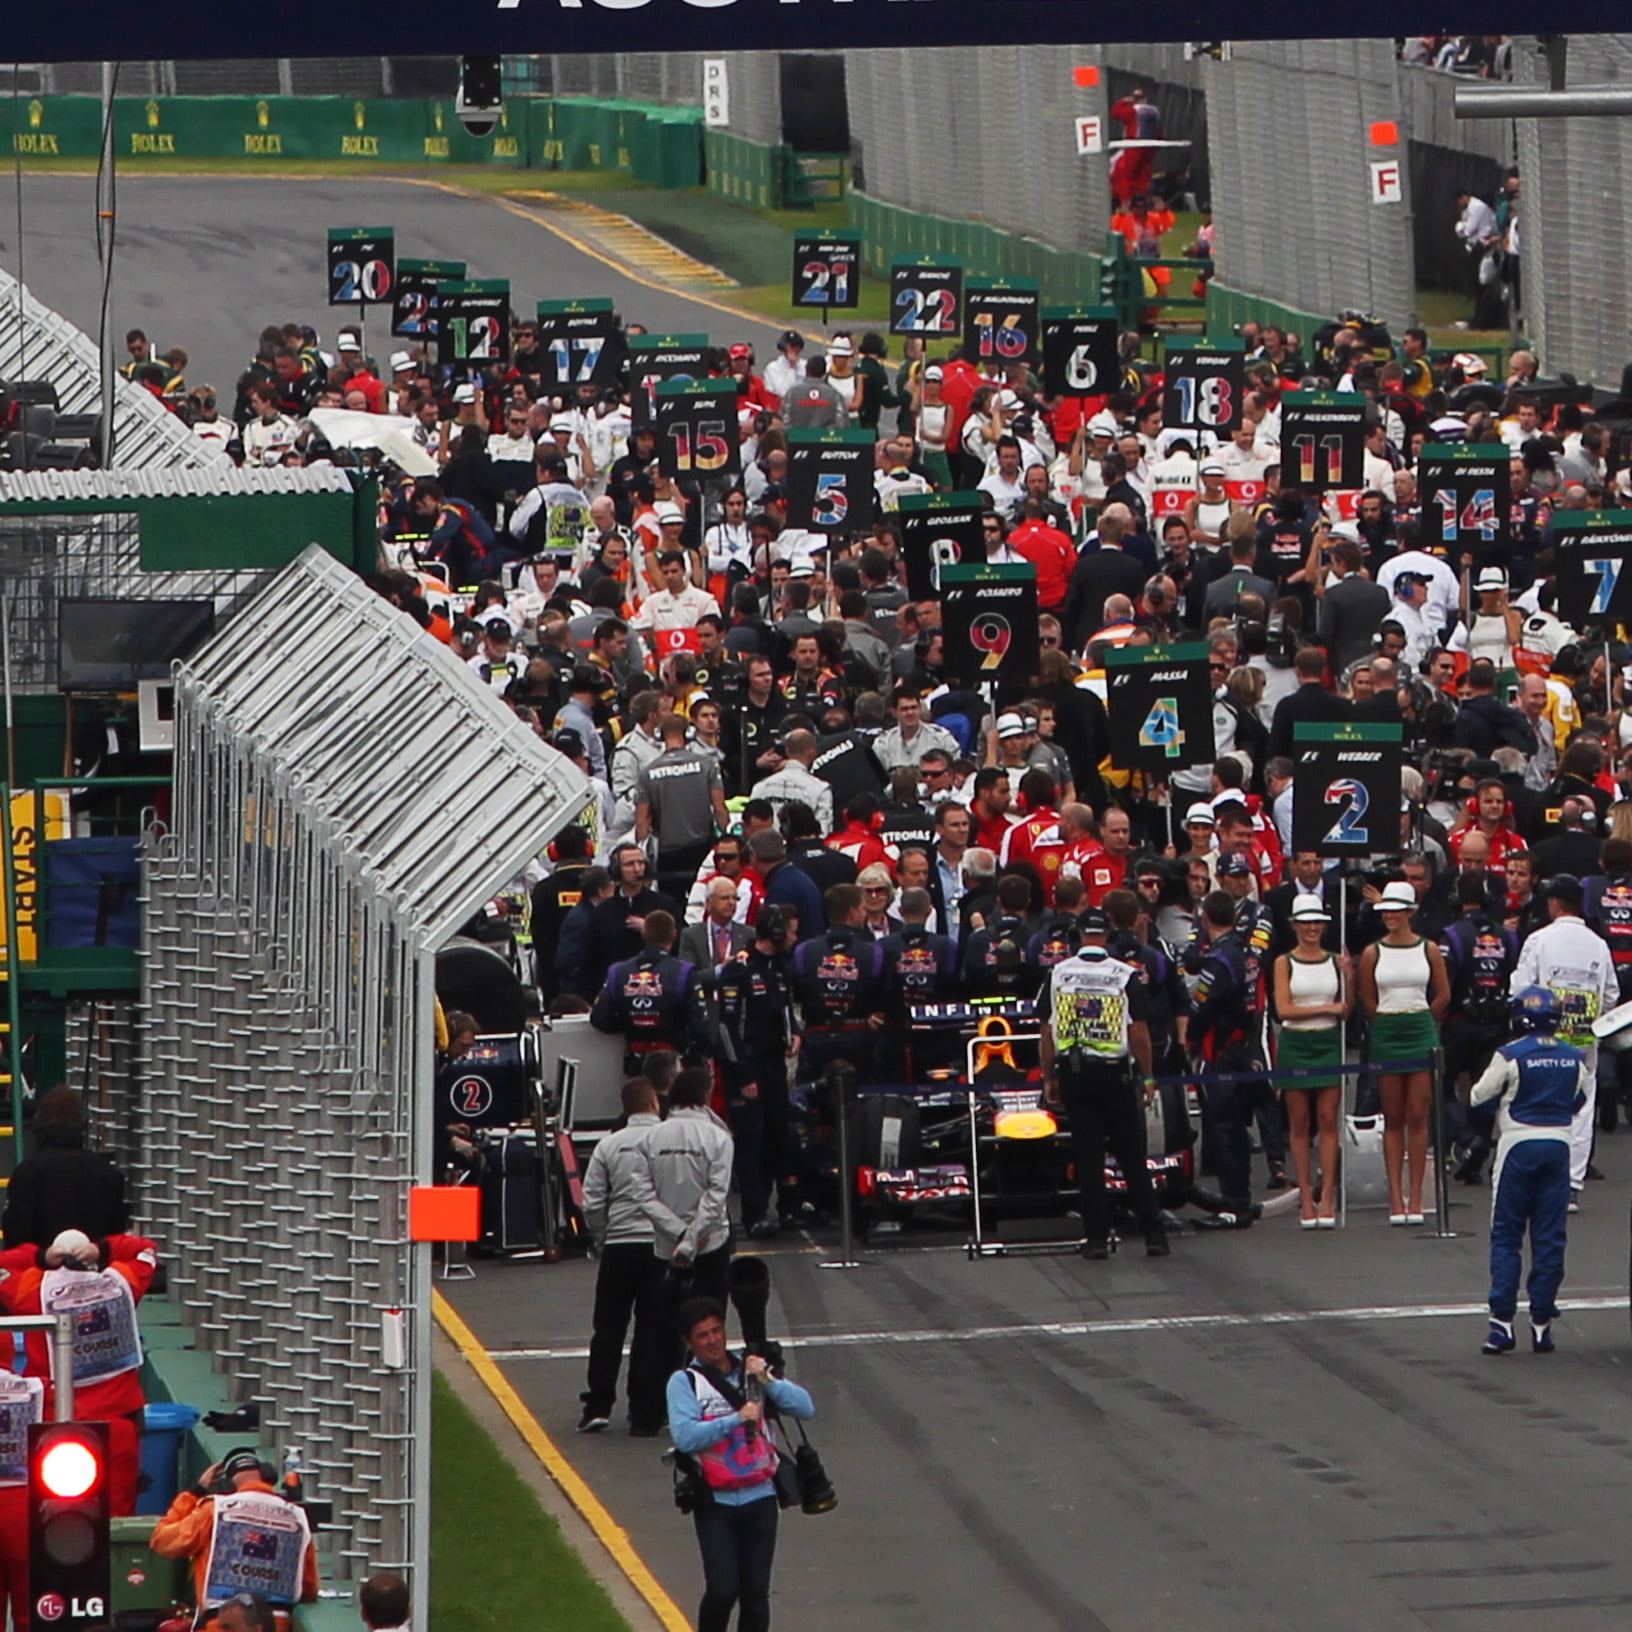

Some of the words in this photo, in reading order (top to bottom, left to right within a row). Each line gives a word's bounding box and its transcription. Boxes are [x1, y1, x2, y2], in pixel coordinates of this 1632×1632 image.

[131, 133, 176, 154] ROLEX
[244, 134, 282, 154] ROLEX
[341, 136, 379, 156] ROLEX
[1081, 123, 1097, 147] F
[1378, 168, 1398, 196] F
[333, 259, 391, 300] 20
[801, 262, 849, 303] 21
[895, 288, 956, 331] 22
[447, 316, 500, 359] 12
[974, 313, 1027, 358] 16
[548, 337, 606, 383] 17
[1065, 344, 1098, 390] 6
[1173, 377, 1233, 426] 18
[667, 421, 729, 471] 15
[820, 450, 861, 460] BUTTON
[1292, 434, 1343, 483] 11
[812, 473, 848, 525] 5
[1432, 489, 1501, 542] 14
[975, 587, 1024, 598] ROSBERG
[1583, 558, 1625, 615] 7
[970, 612, 1012, 670] 9
[1150, 670, 1189, 683] MASSA
[1139, 697, 1186, 757] 4
[1333, 732, 1363, 741] ROLEX
[649, 760, 702, 780] PETRONAS
[1337, 752, 1383, 762] WEBBER
[1322, 778, 1371, 843] 2
[1526, 1058, 1559, 1069] SAFETY
[1560, 1057, 1576, 1068] CAR
[462, 1081, 481, 1111] 2
[73, 1336, 120, 1356] COURSE
[232, 1562, 282, 1581] COURSE
[71, 1597, 104, 1617] LG
